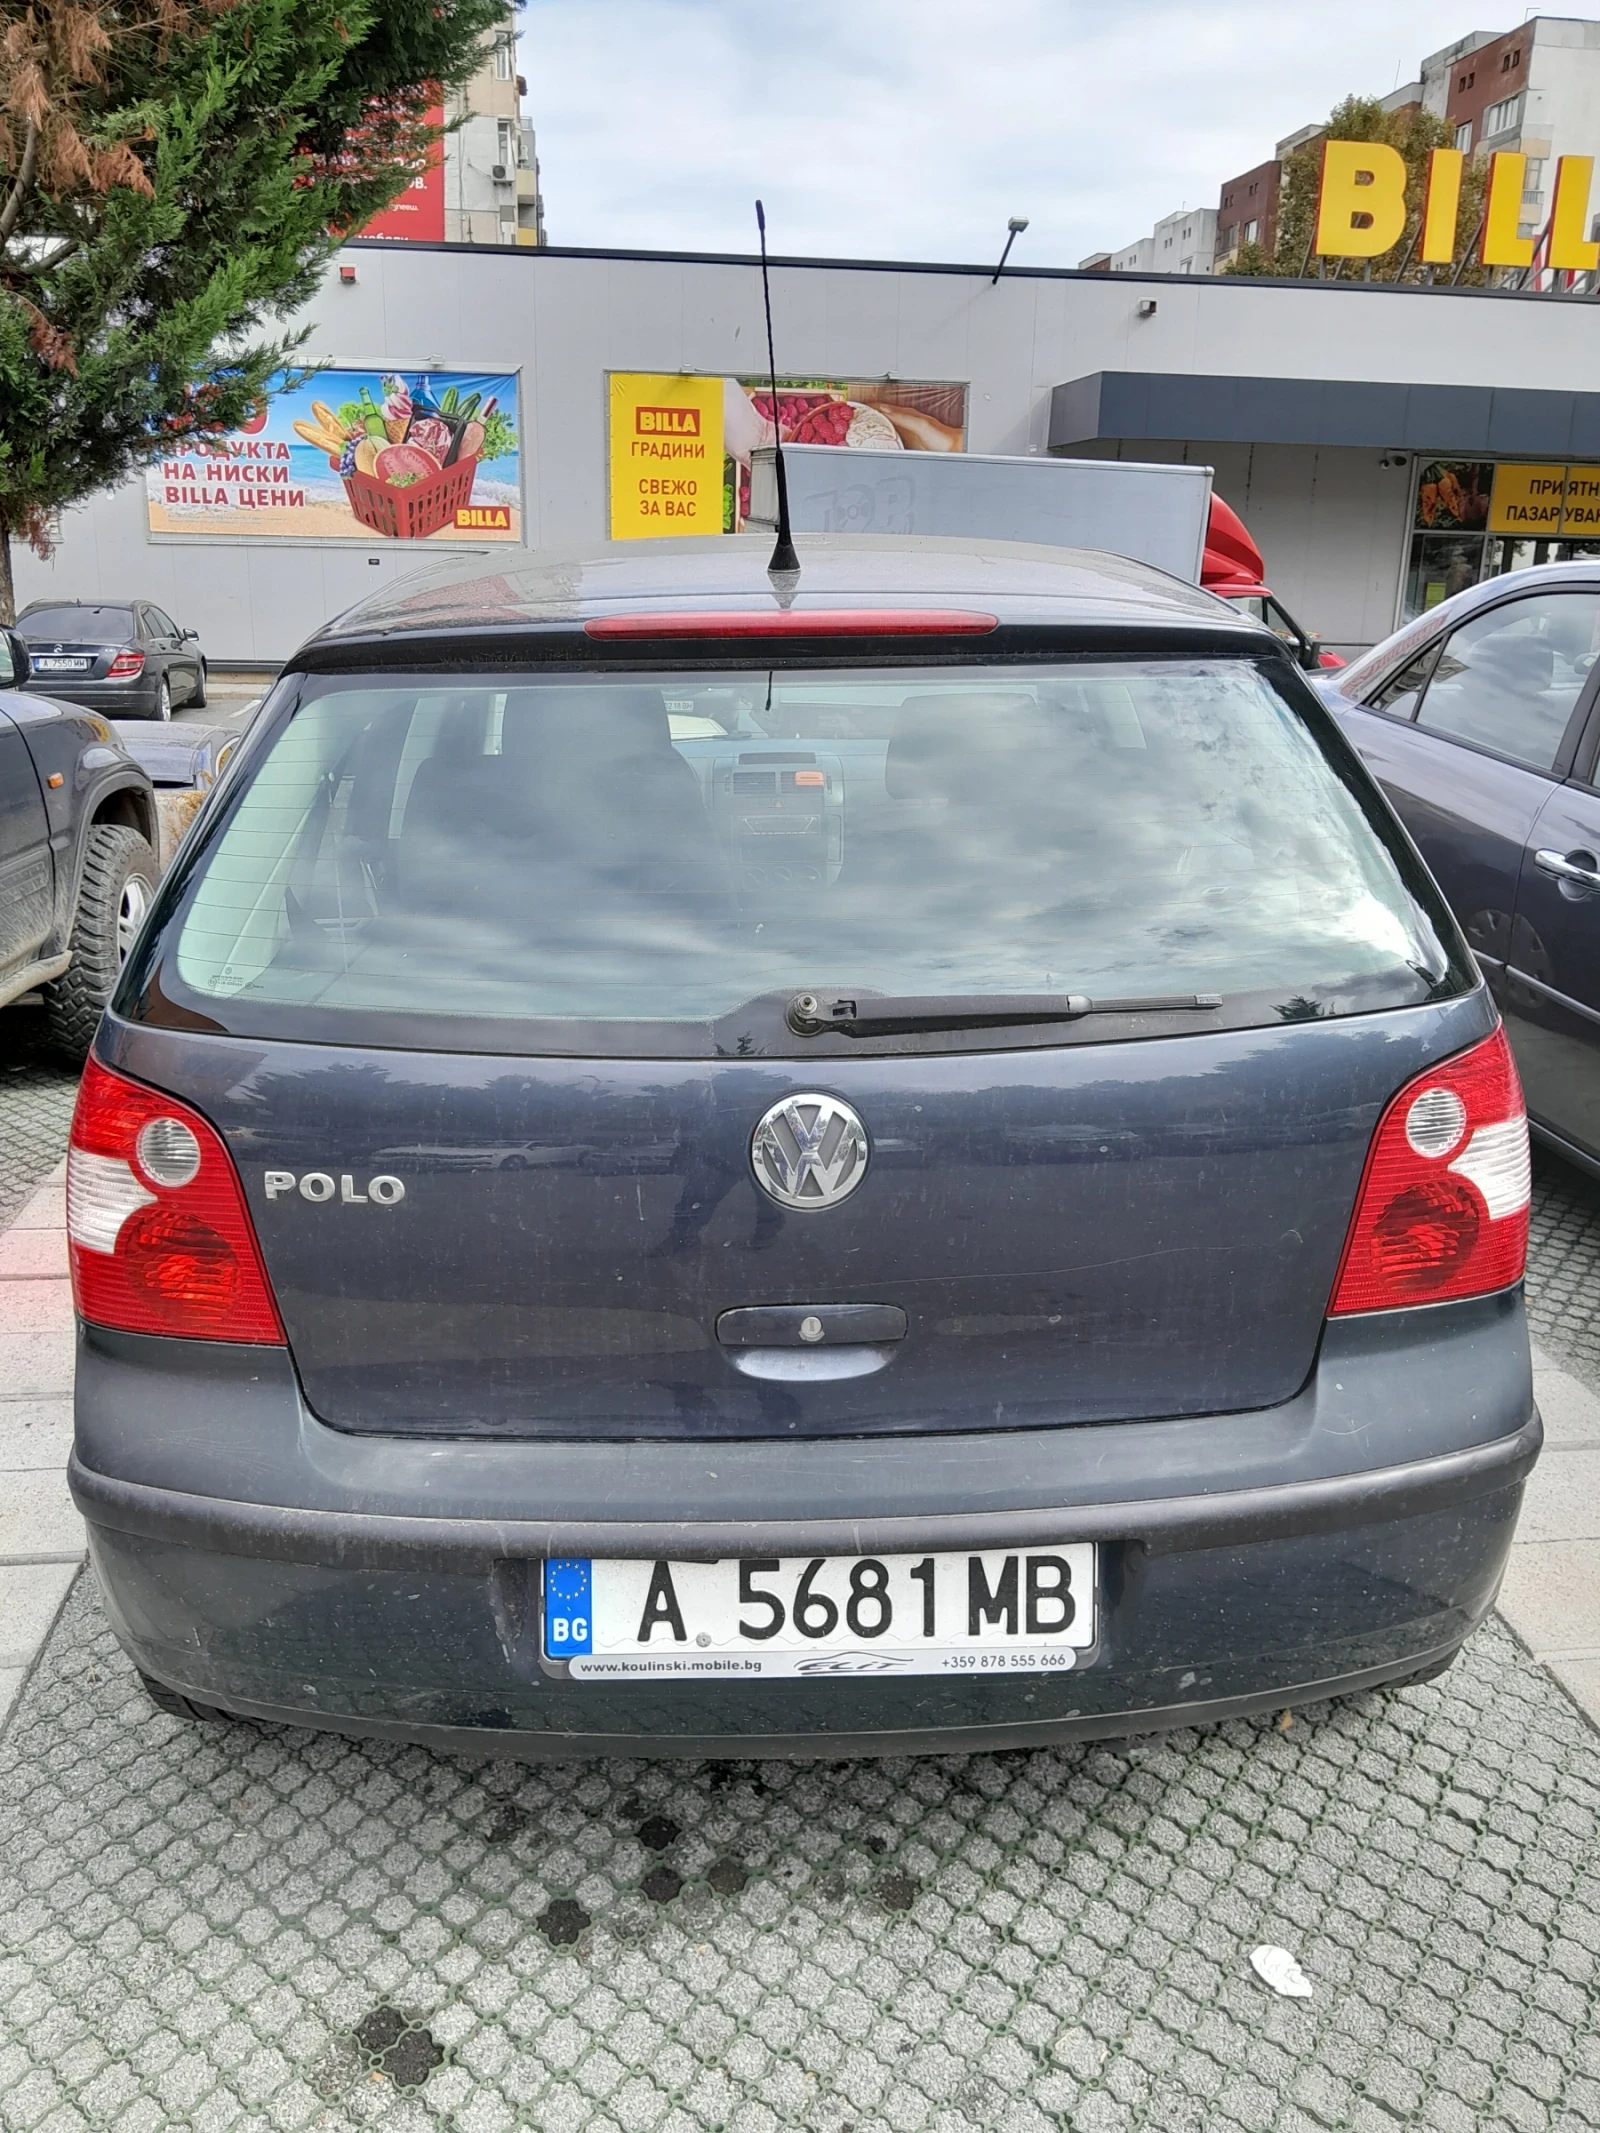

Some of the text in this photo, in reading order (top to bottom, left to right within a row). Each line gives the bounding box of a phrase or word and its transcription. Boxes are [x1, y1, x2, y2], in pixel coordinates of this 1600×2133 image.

[1314, 140, 1600, 270] BILL
[640, 411, 697, 433] BILLA
[168, 440, 290, 461] РОДУКТА
[631, 441, 705, 460] ГРАДИНИ
[163, 462, 289, 484] НА НИСКИ
[165, 486, 304, 509] BILLA ЦЕНИ
[638, 478, 698, 496] СВЕЖО
[456, 509, 508, 527] BILLA
[639, 499, 697, 517] ЗА ВАС
[43, 659, 49, 668] A
[263, 1170, 407, 1205] POLO
[637, 1554, 1077, 1642] A 5681 MB
[552, 1617, 588, 1643] BG
[580, 1659, 763, 1673] www.koulinski.mobile.bg
[941, 1653, 1067, 1669] +359 878 555 666
